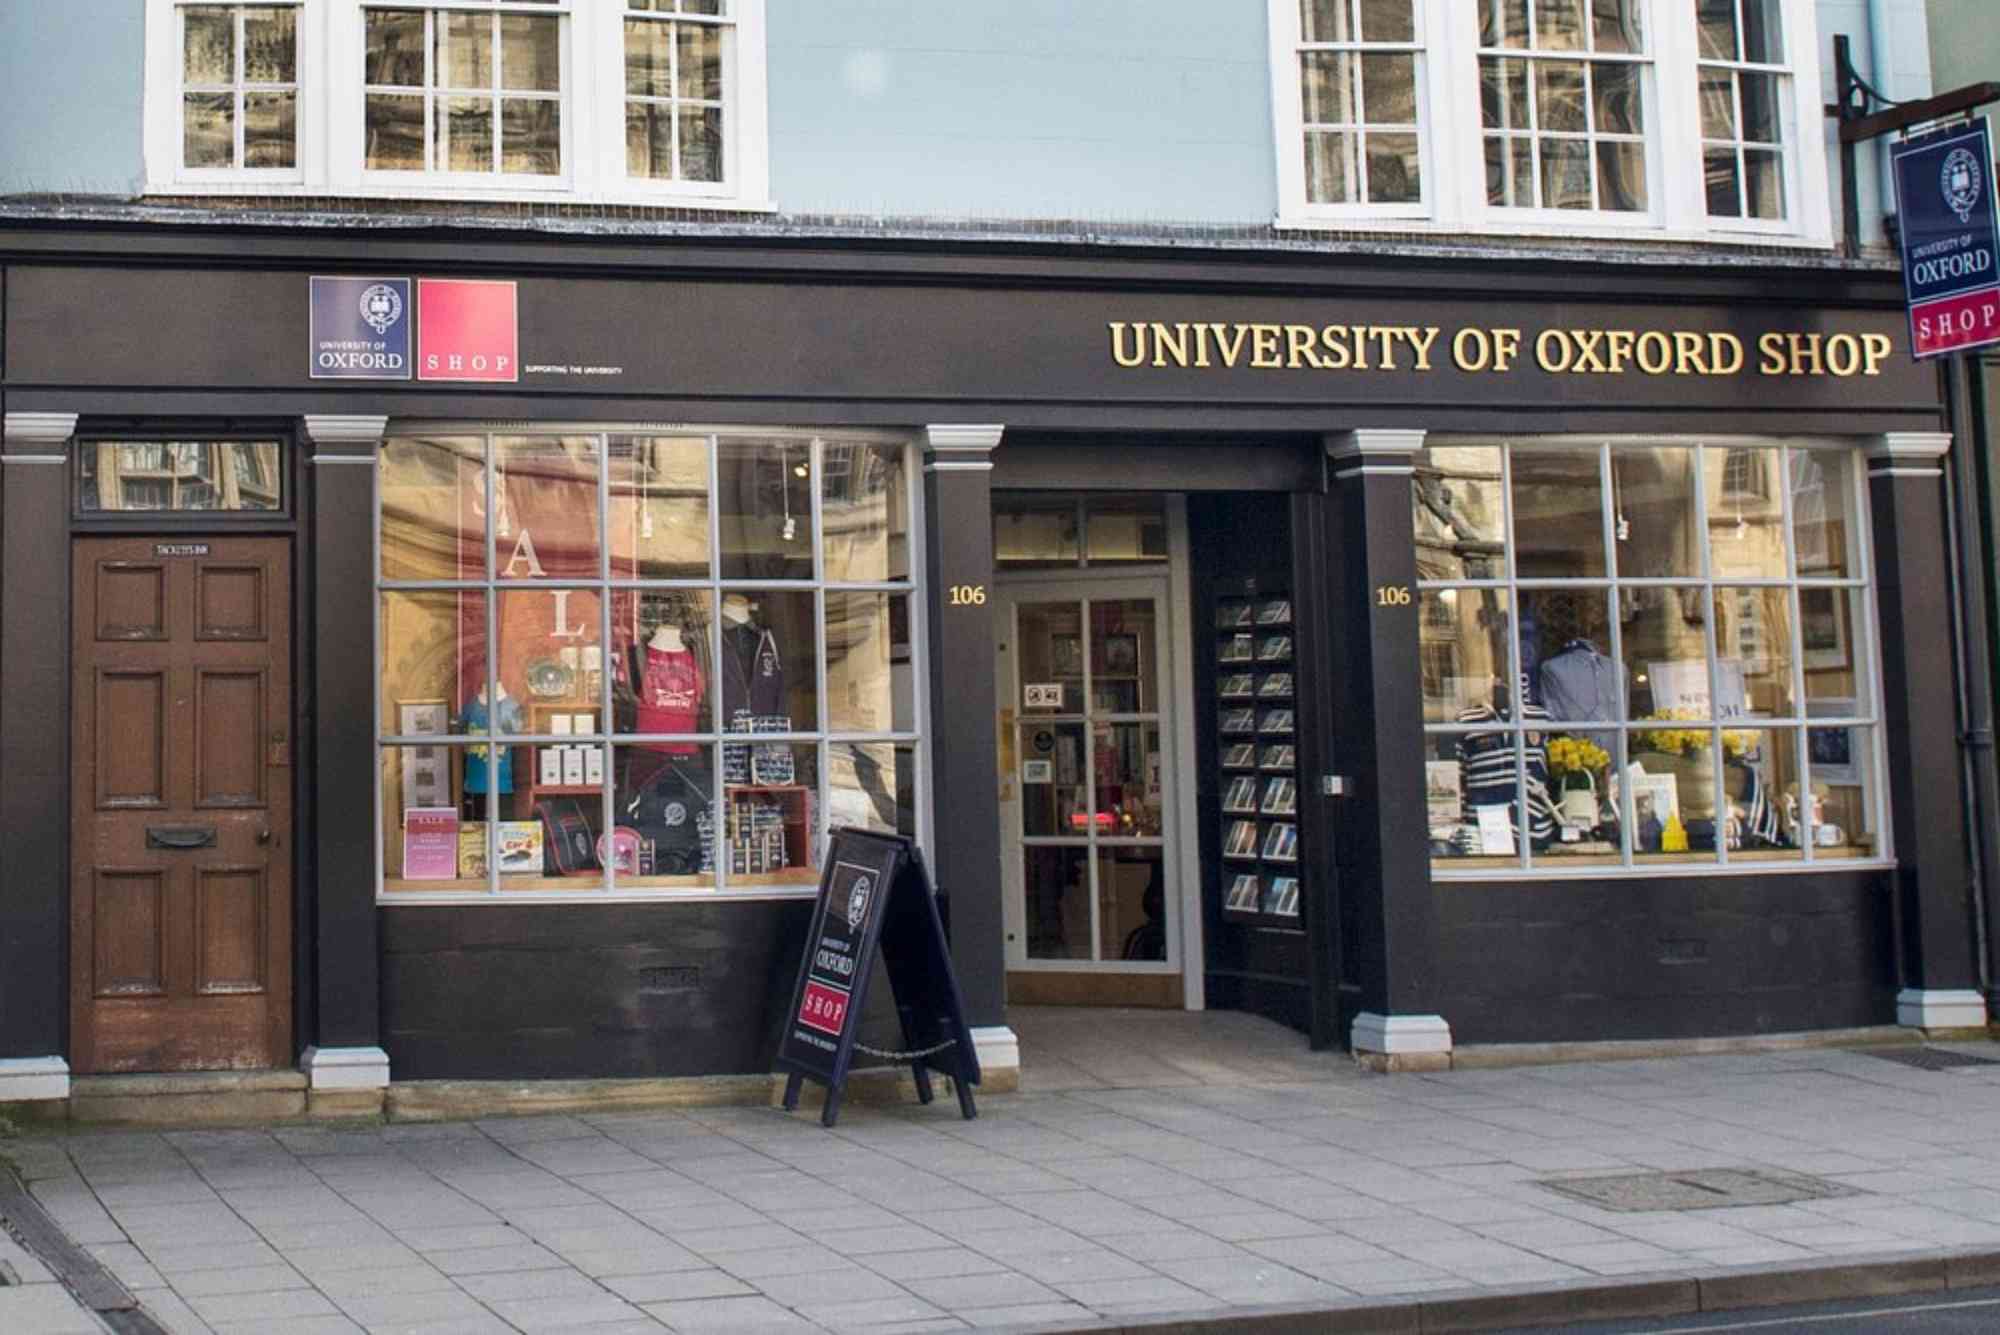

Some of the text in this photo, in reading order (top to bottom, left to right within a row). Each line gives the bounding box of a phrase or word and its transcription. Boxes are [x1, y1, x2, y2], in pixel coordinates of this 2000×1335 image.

[1913, 249, 1990, 285] OXFORD
[1919, 304, 1995, 340] SHOP
[319, 341, 386, 351] UNIVERSITY OF
[1108, 322, 1892, 377] UNIVERSITY OF OXFORD SHOP
[319, 352, 403, 368] OXFORD
[427, 355, 509, 371] SHOP
[950, 585, 985, 605] 106
[1378, 586, 1410, 606] 106
[805, 993, 843, 1021] SHOP
